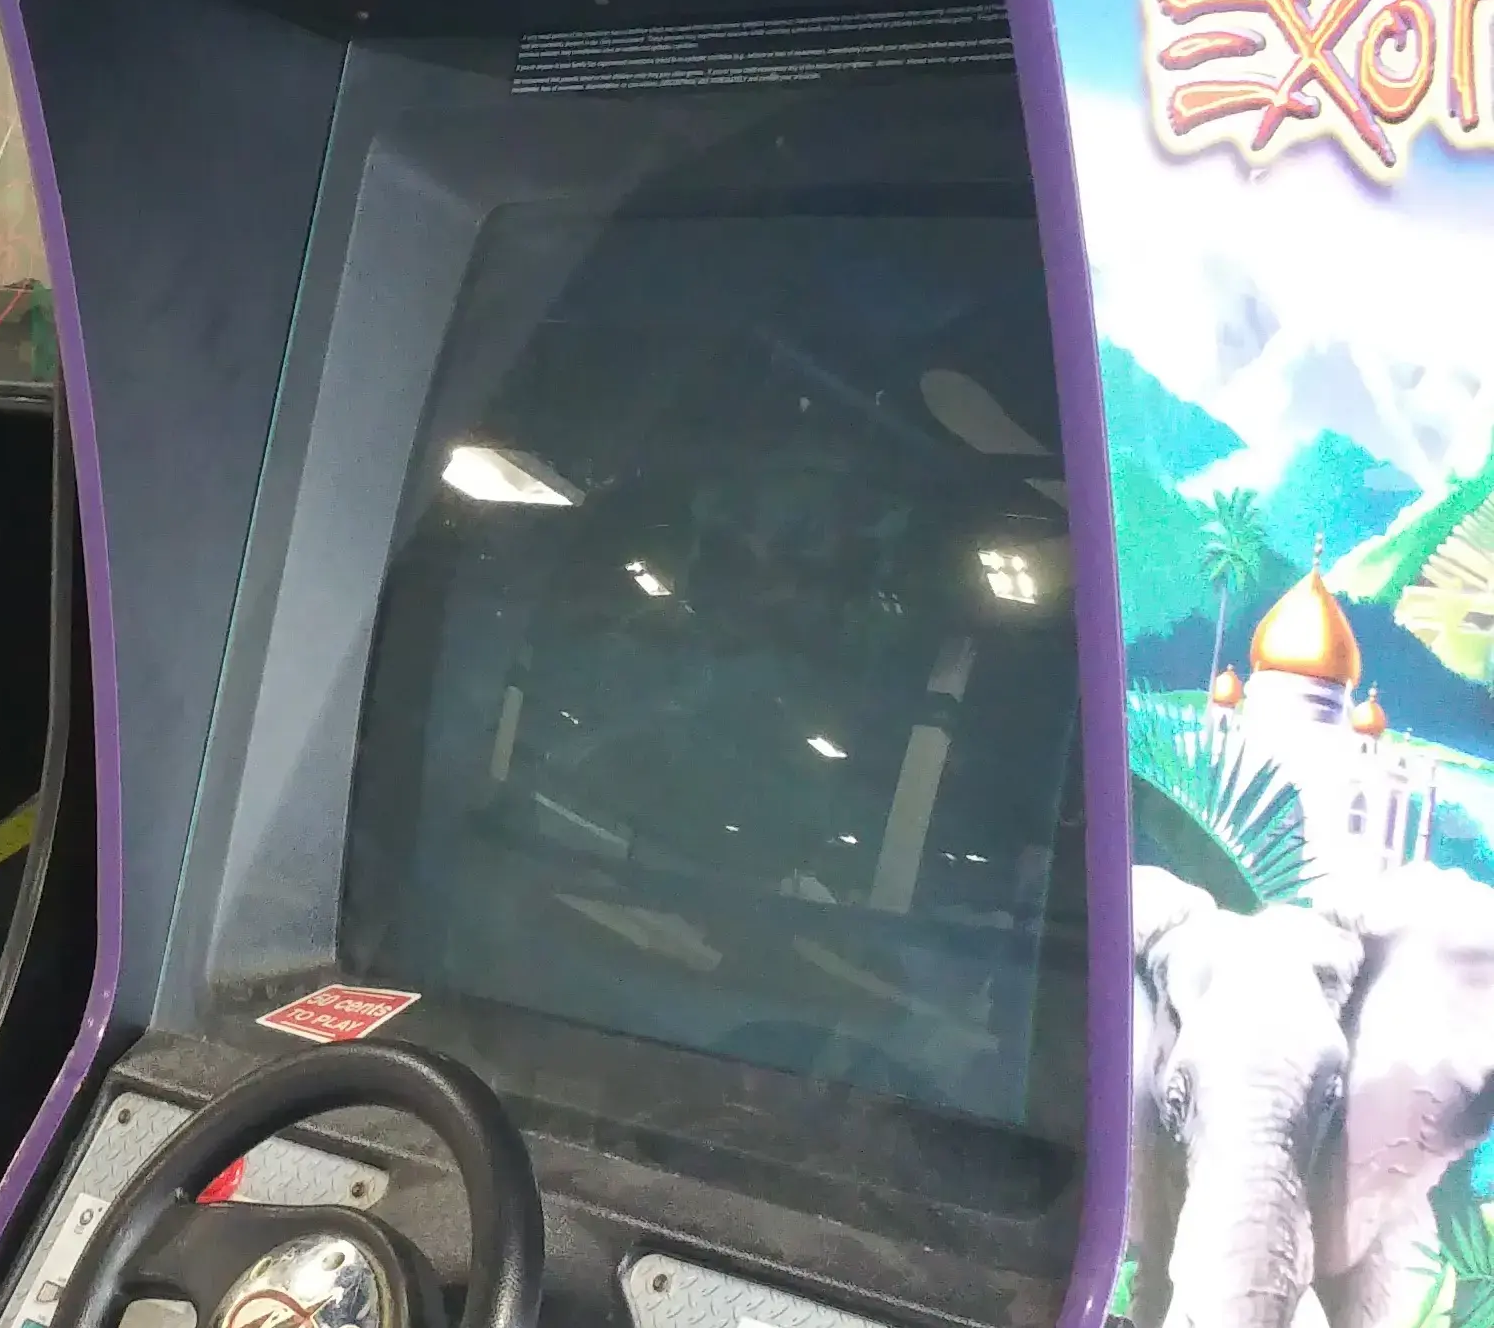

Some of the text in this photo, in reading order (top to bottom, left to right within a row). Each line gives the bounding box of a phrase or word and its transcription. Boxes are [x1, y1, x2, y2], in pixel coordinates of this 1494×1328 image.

[307, 992, 393, 1018] 50 cents
[286, 1008, 366, 1033] TO PLAY
